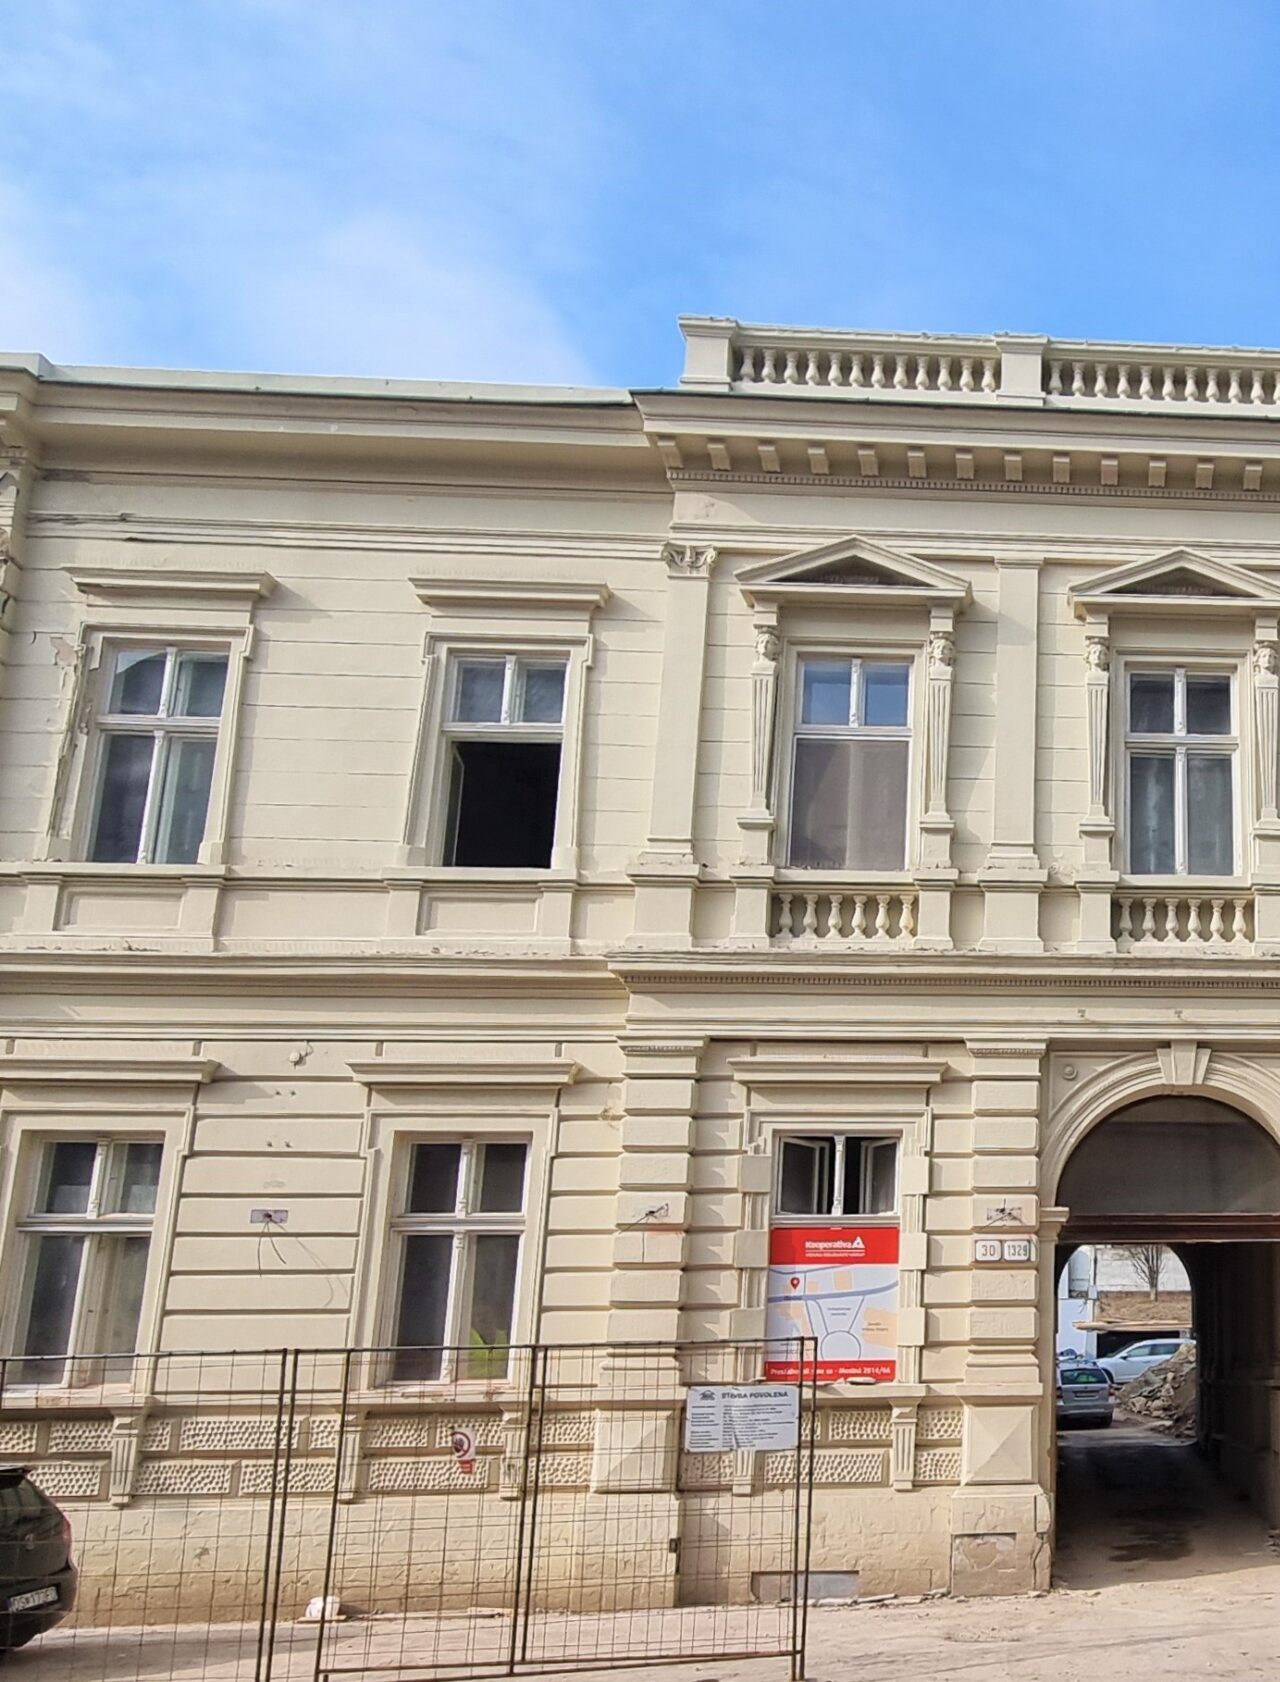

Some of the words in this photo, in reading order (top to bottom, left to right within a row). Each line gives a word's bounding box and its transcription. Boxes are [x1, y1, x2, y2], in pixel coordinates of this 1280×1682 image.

[805, 1240, 852, 1250] Kooperativa
[981, 1244, 996, 1257] 30
[1007, 1244, 1028, 1257] 1329
